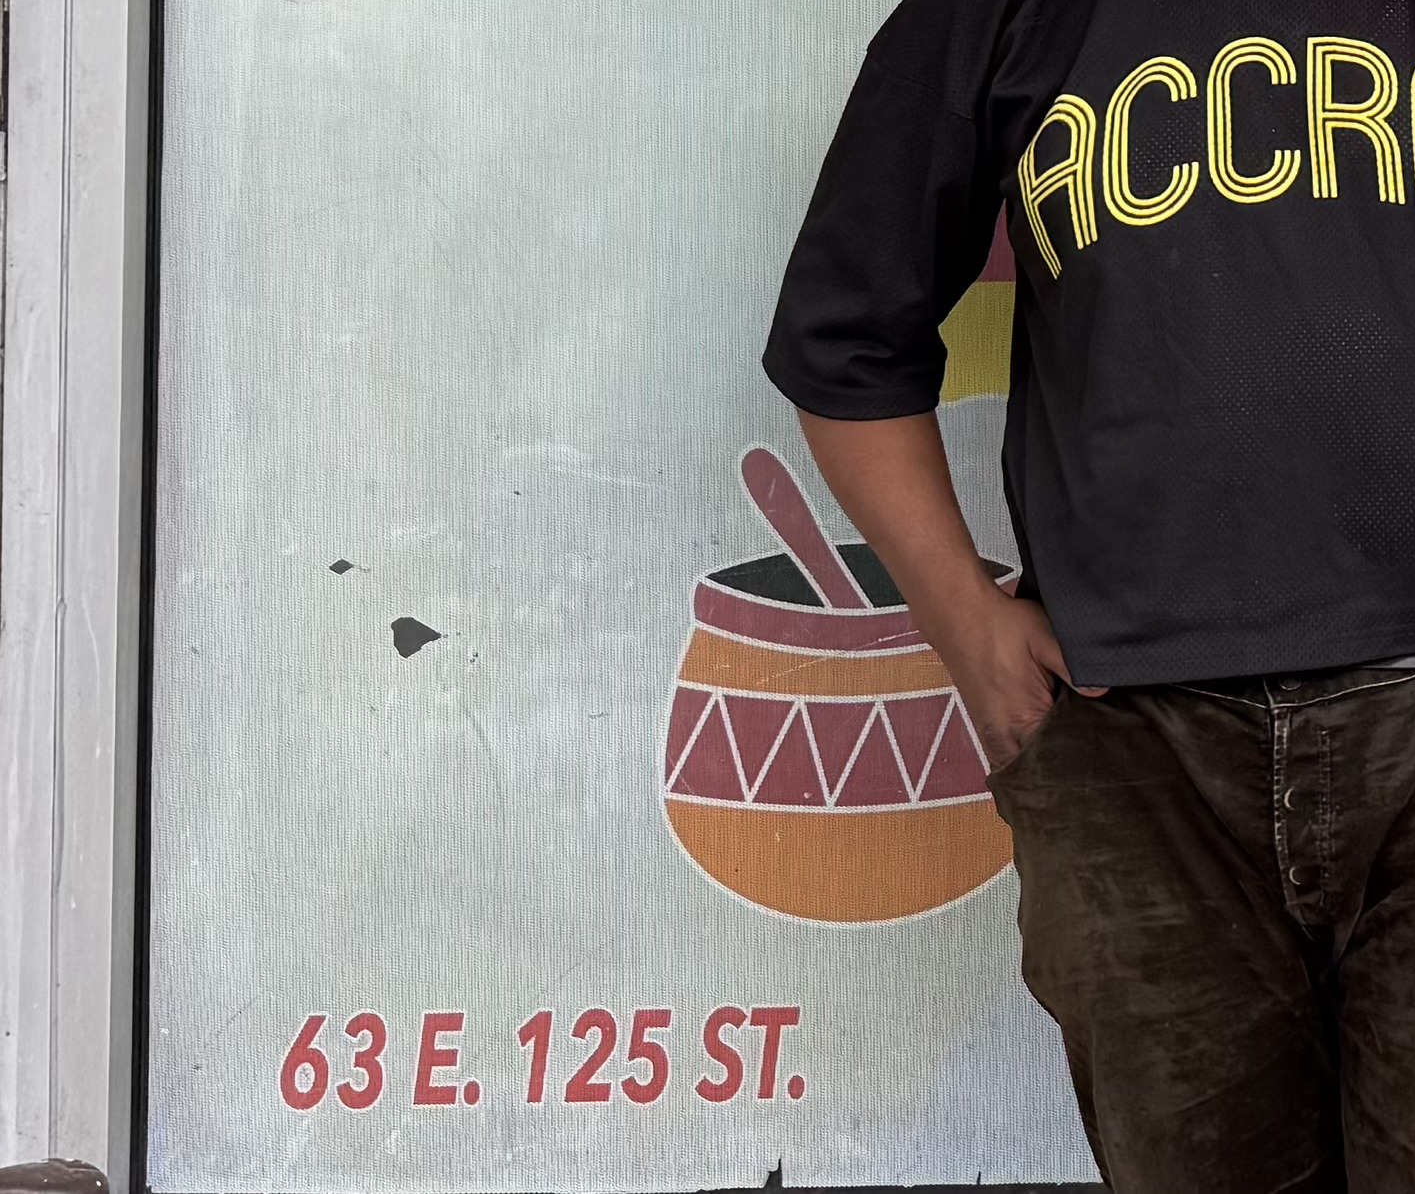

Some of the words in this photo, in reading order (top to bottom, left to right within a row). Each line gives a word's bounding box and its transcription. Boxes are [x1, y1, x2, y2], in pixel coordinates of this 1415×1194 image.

[279, 1010, 387, 1111] 63
[412, 1011, 482, 1106] E.
[516, 1006, 673, 1105] 125
[694, 1004, 807, 1103] ST.
